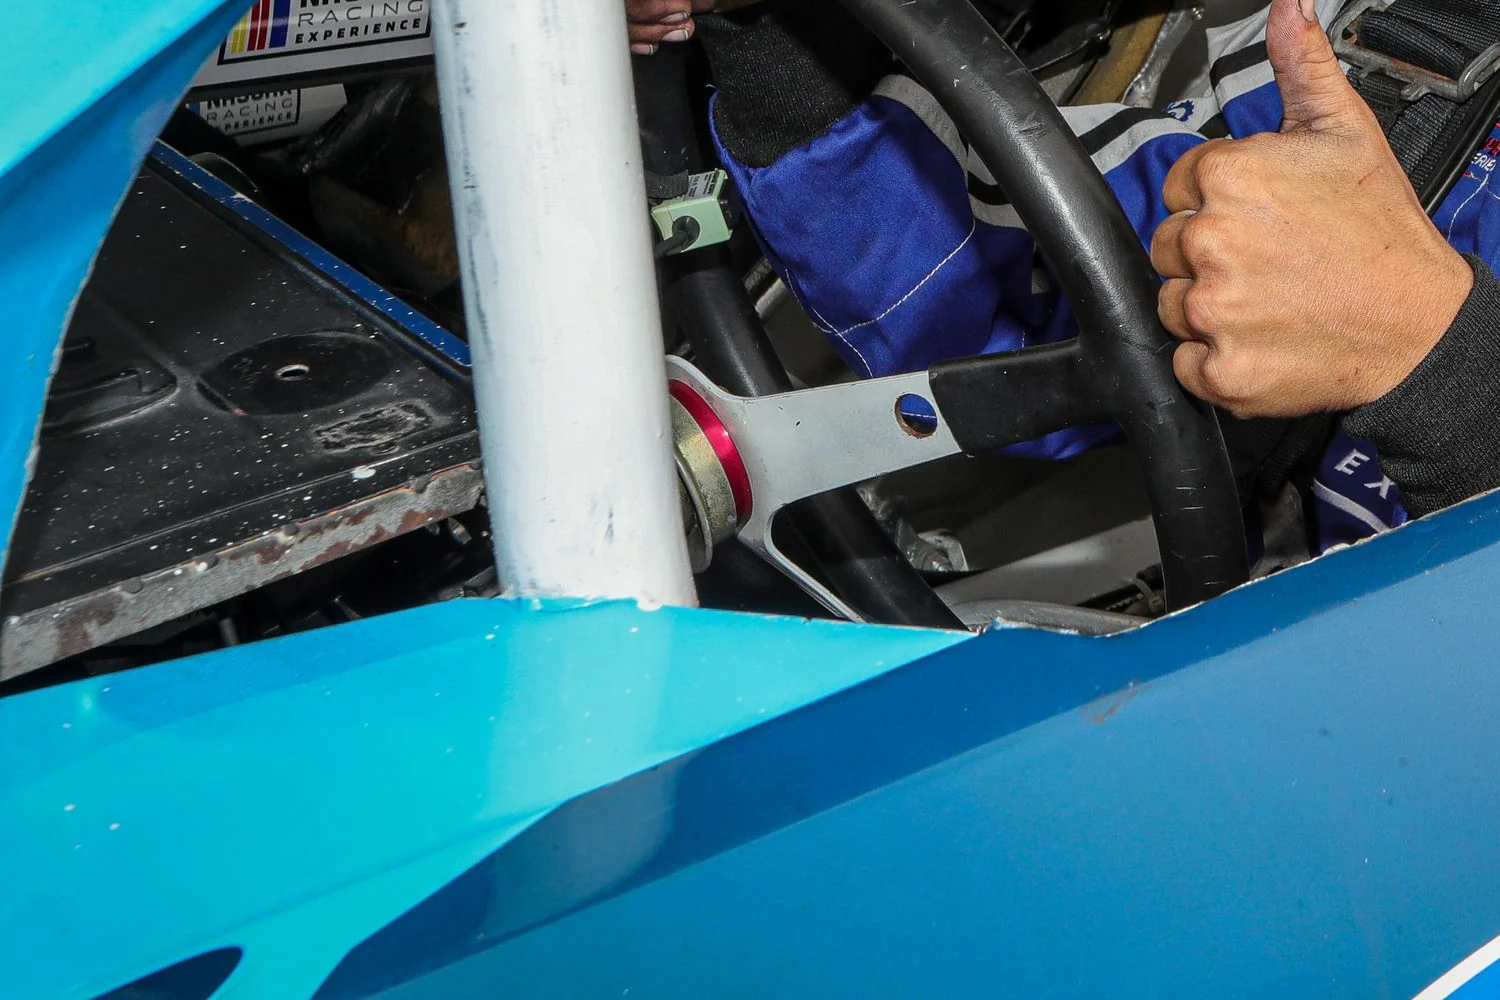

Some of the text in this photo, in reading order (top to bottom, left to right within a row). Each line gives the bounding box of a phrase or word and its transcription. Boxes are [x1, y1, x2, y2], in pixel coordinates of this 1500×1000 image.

[294, 18, 421, 45] EXPERIENCE
[207, 98, 293, 121] RACING
[224, 111, 292, 132] PERIENCE
